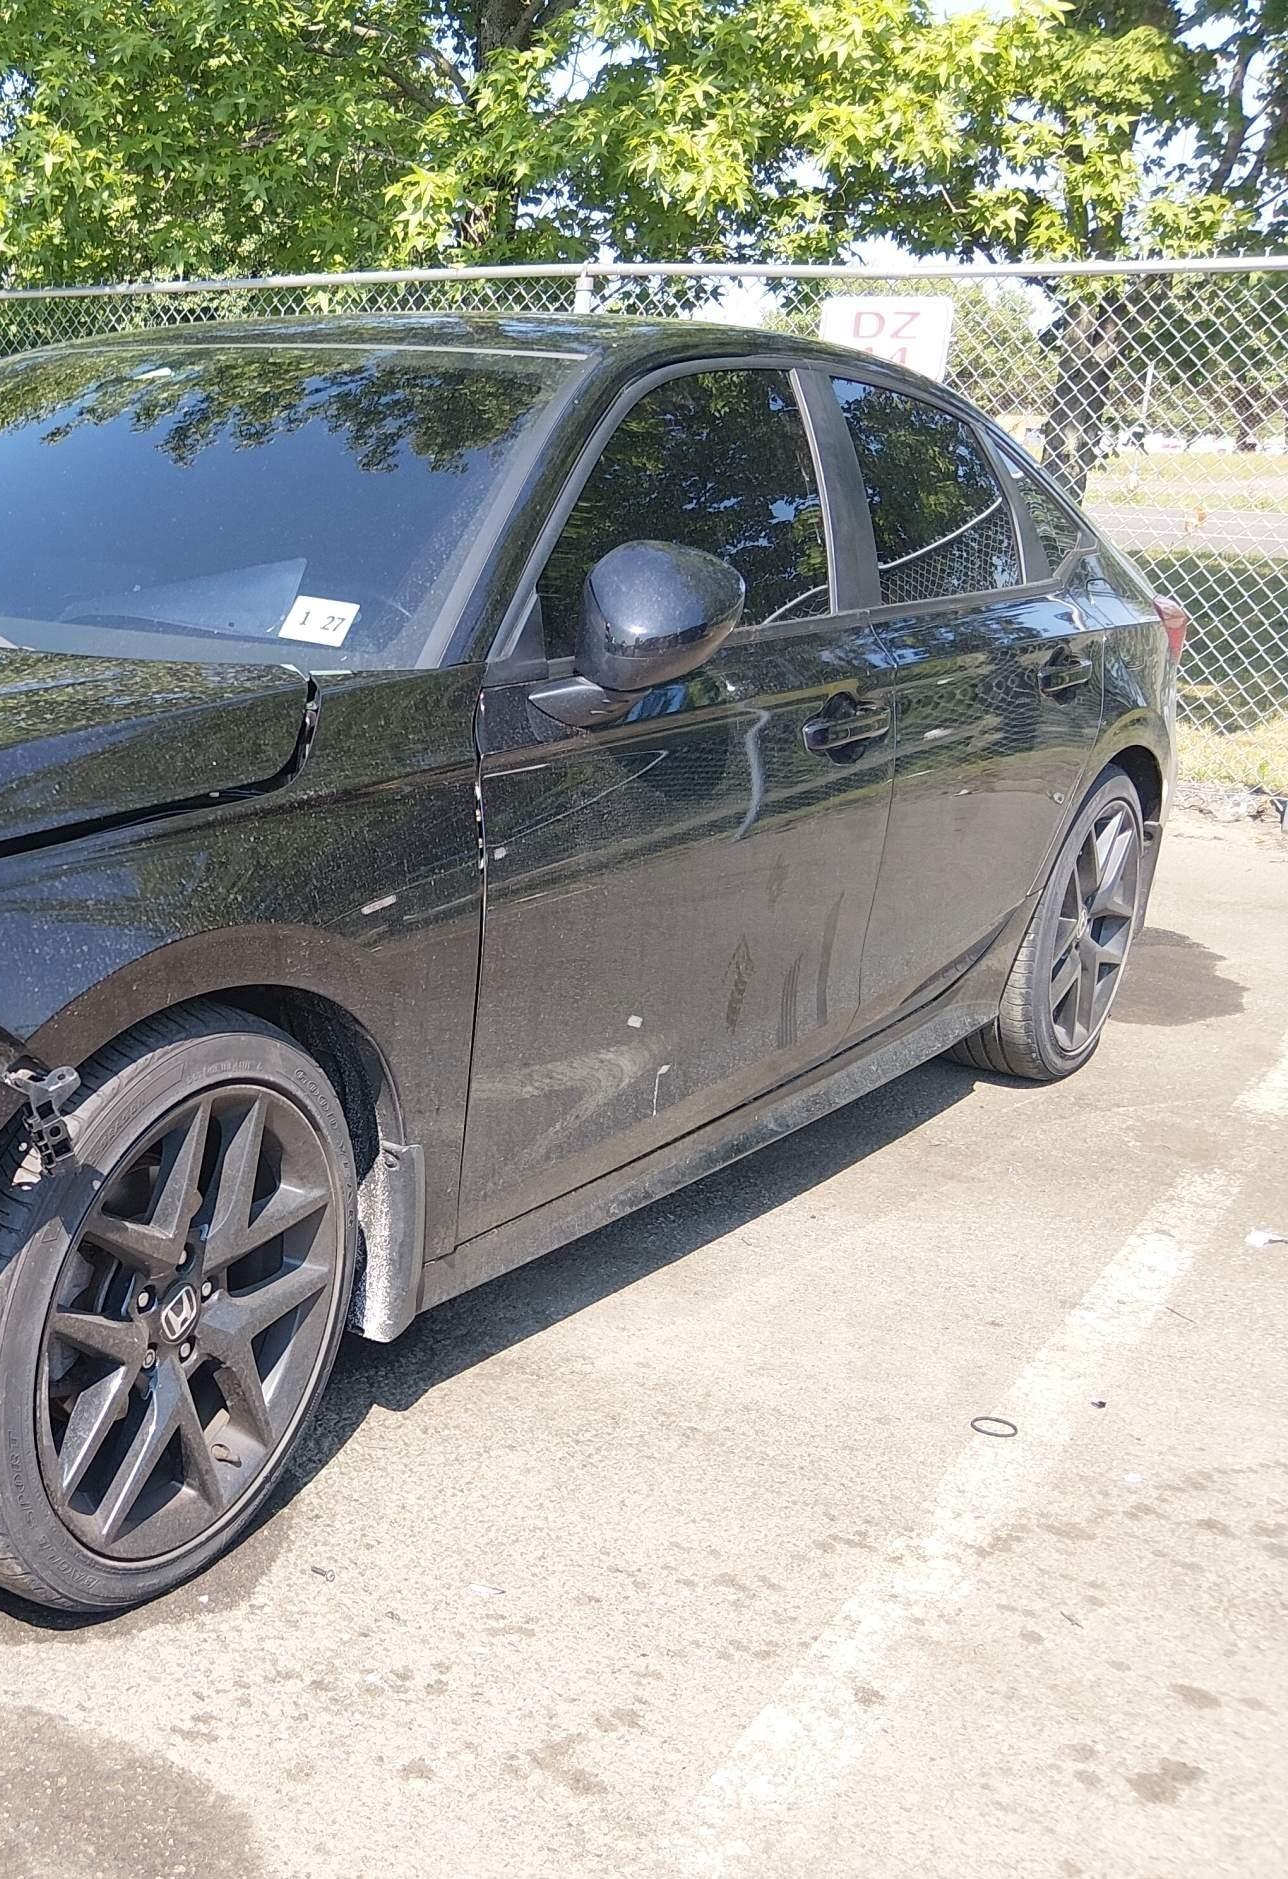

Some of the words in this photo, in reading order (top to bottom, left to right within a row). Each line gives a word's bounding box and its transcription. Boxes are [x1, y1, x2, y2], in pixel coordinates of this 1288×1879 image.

[852, 311, 921, 340] DZ
[298, 610, 312, 626] 1
[319, 615, 347, 633] 27
